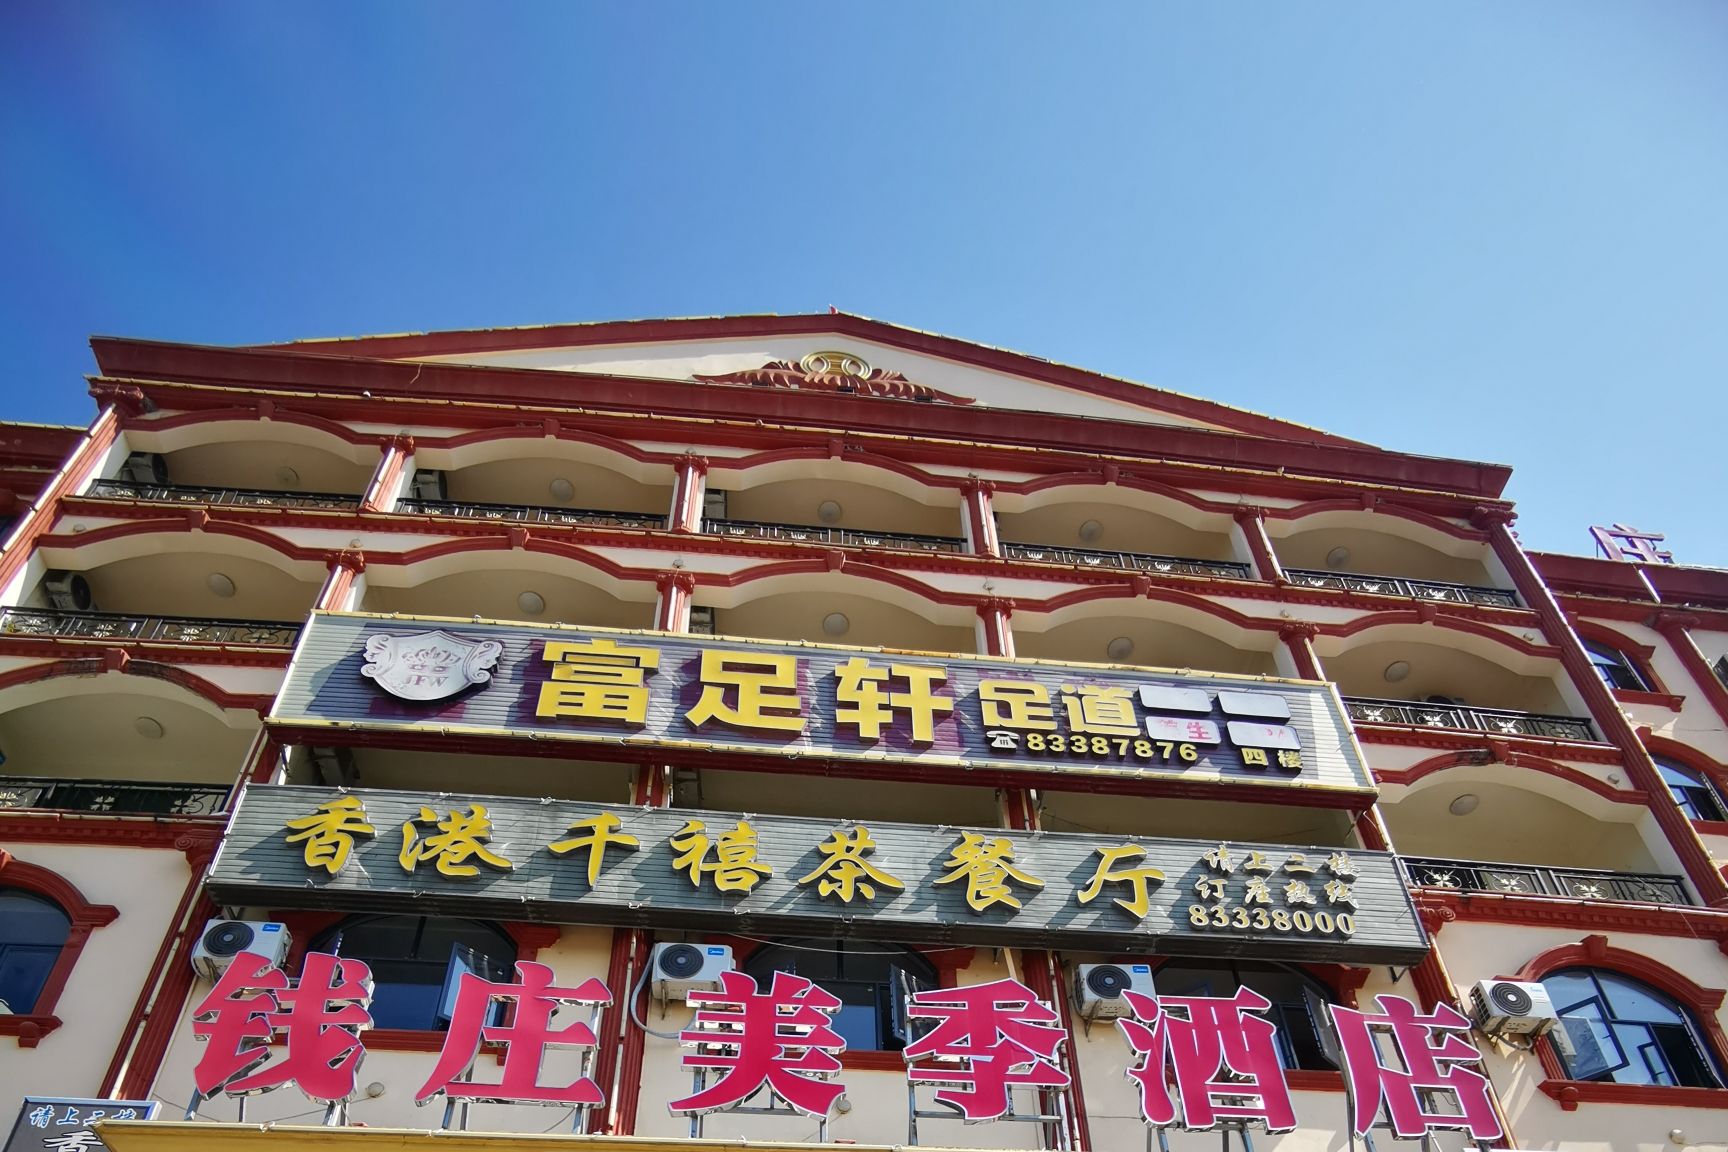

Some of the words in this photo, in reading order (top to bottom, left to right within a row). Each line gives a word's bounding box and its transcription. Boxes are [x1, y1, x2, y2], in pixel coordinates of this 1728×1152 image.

[1027, 733, 1199, 763] 83387876
[285, 796, 1166, 920] 香港千禧茶餐厅
[1203, 845, 1360, 878] 请上二楼
[1195, 874, 1359, 910] 订座热线
[1189, 904, 1356, 936] 83338000
[192, 950, 1504, 1141] 钱庄美季酒店
